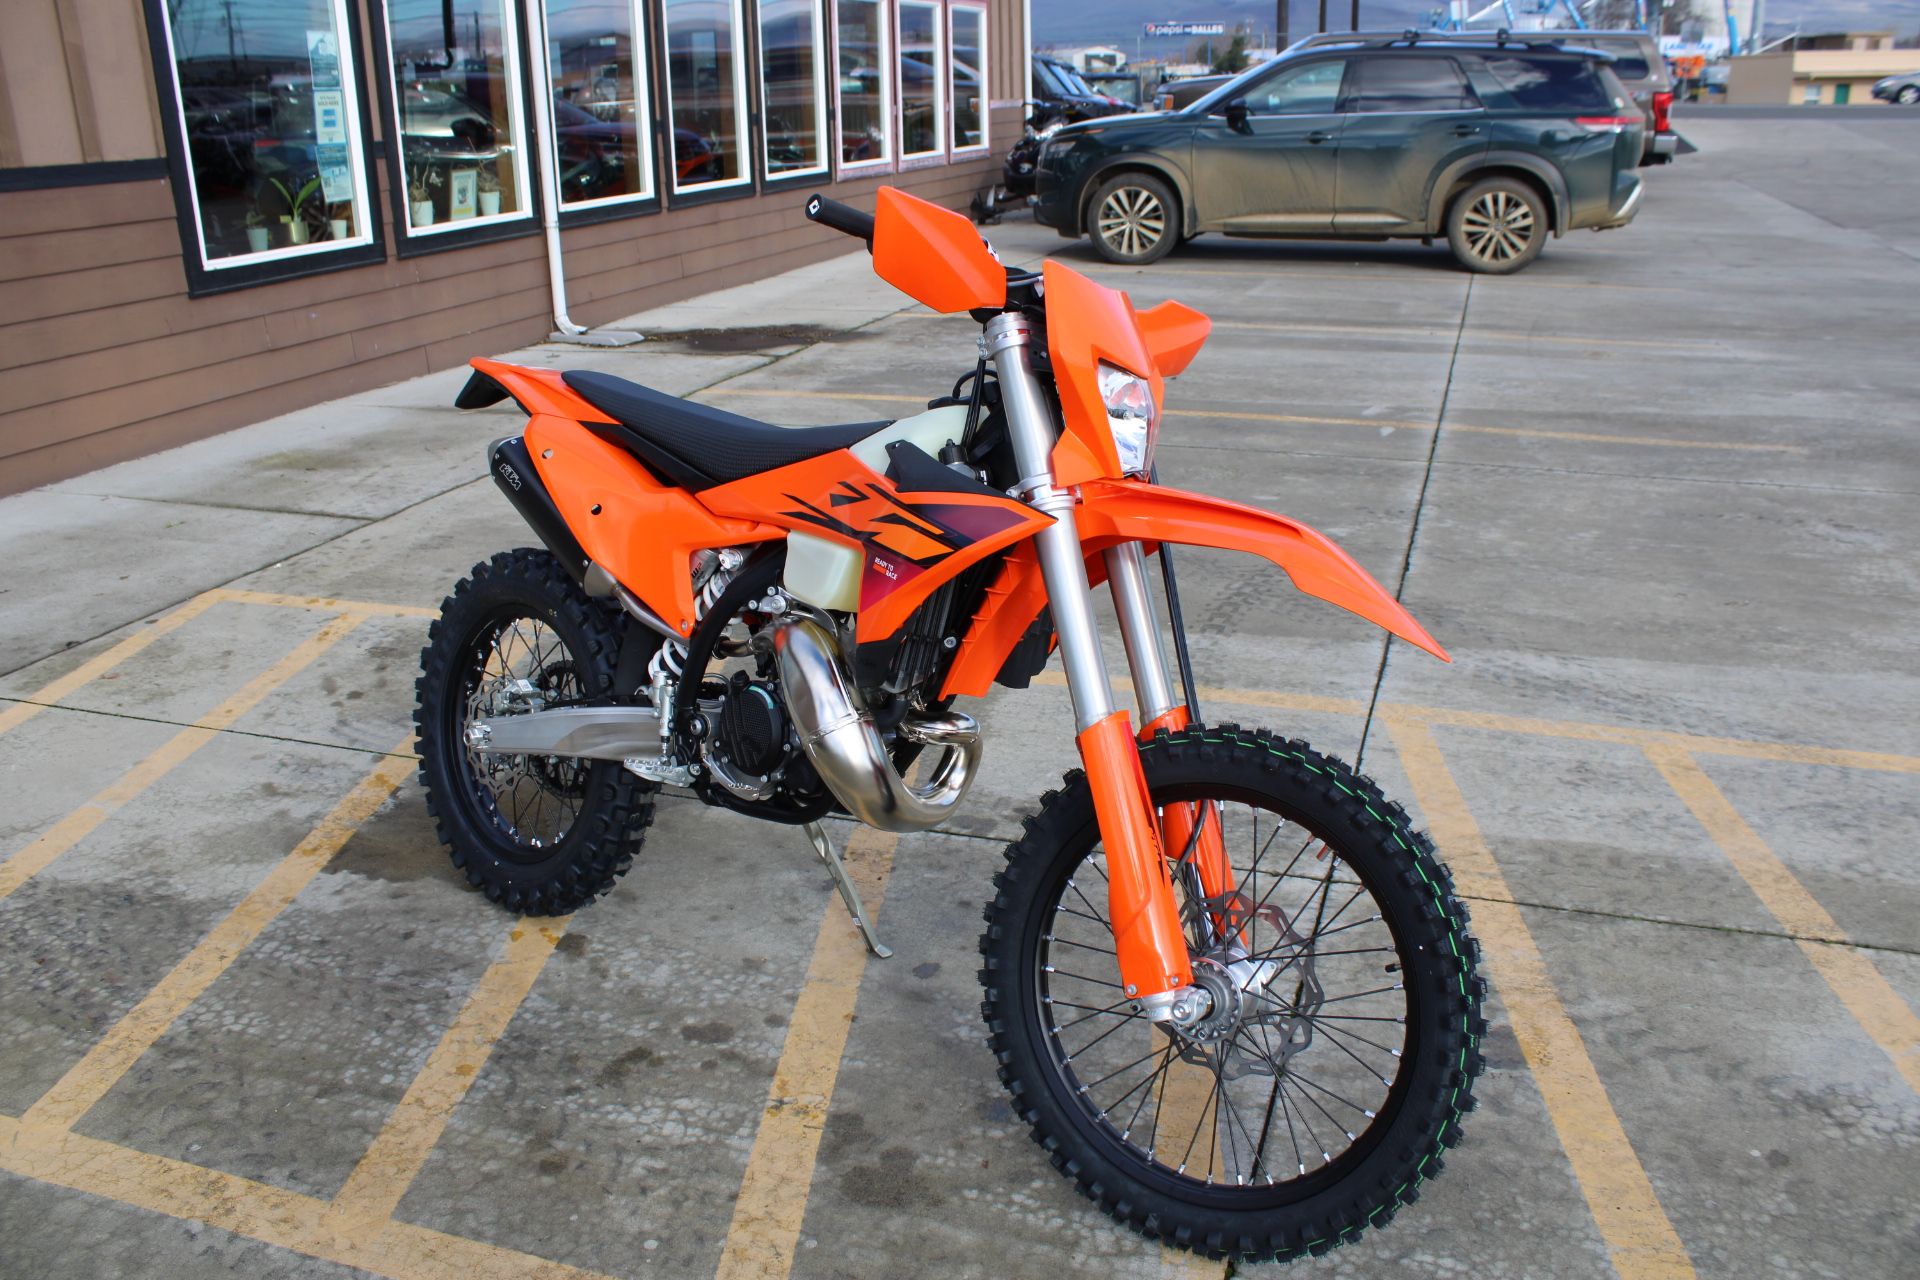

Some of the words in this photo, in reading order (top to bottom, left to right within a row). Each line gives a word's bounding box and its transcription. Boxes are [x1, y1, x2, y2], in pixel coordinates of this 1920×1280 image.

[499, 463, 521, 491] KTM
[874, 556, 888, 569] READY
[885, 569, 897, 581] RACE
